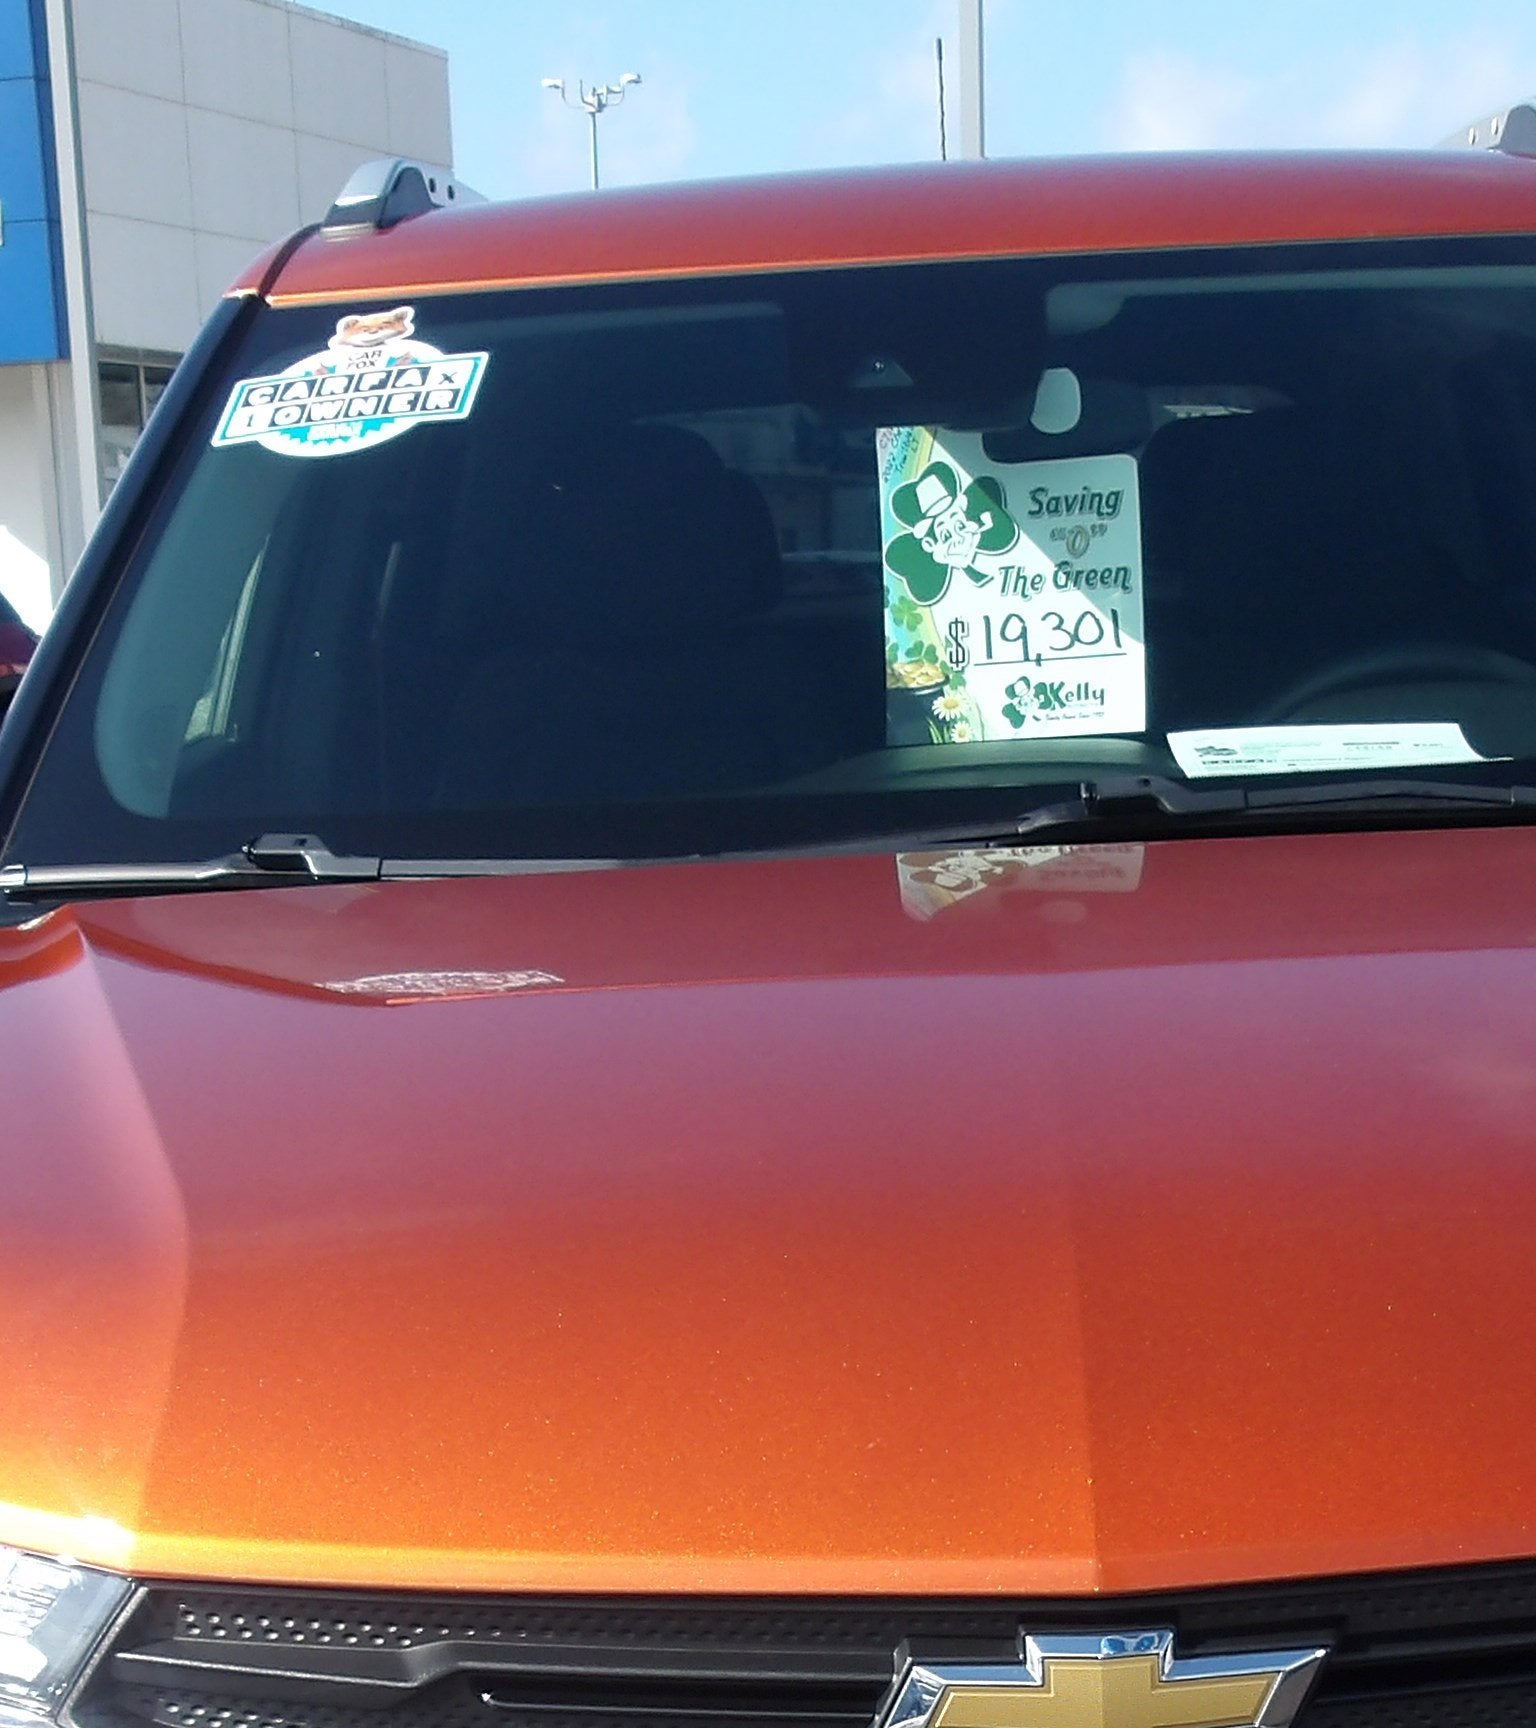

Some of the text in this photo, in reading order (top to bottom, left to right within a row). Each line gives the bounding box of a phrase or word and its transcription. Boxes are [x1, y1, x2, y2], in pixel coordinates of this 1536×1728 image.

[243, 365, 459, 409] CARFAX
[270, 388, 458, 427] OWNER
[1028, 486, 1124, 520] Saving
[998, 560, 1132, 600] The Green
[1049, 681, 1104, 711] Kelly
